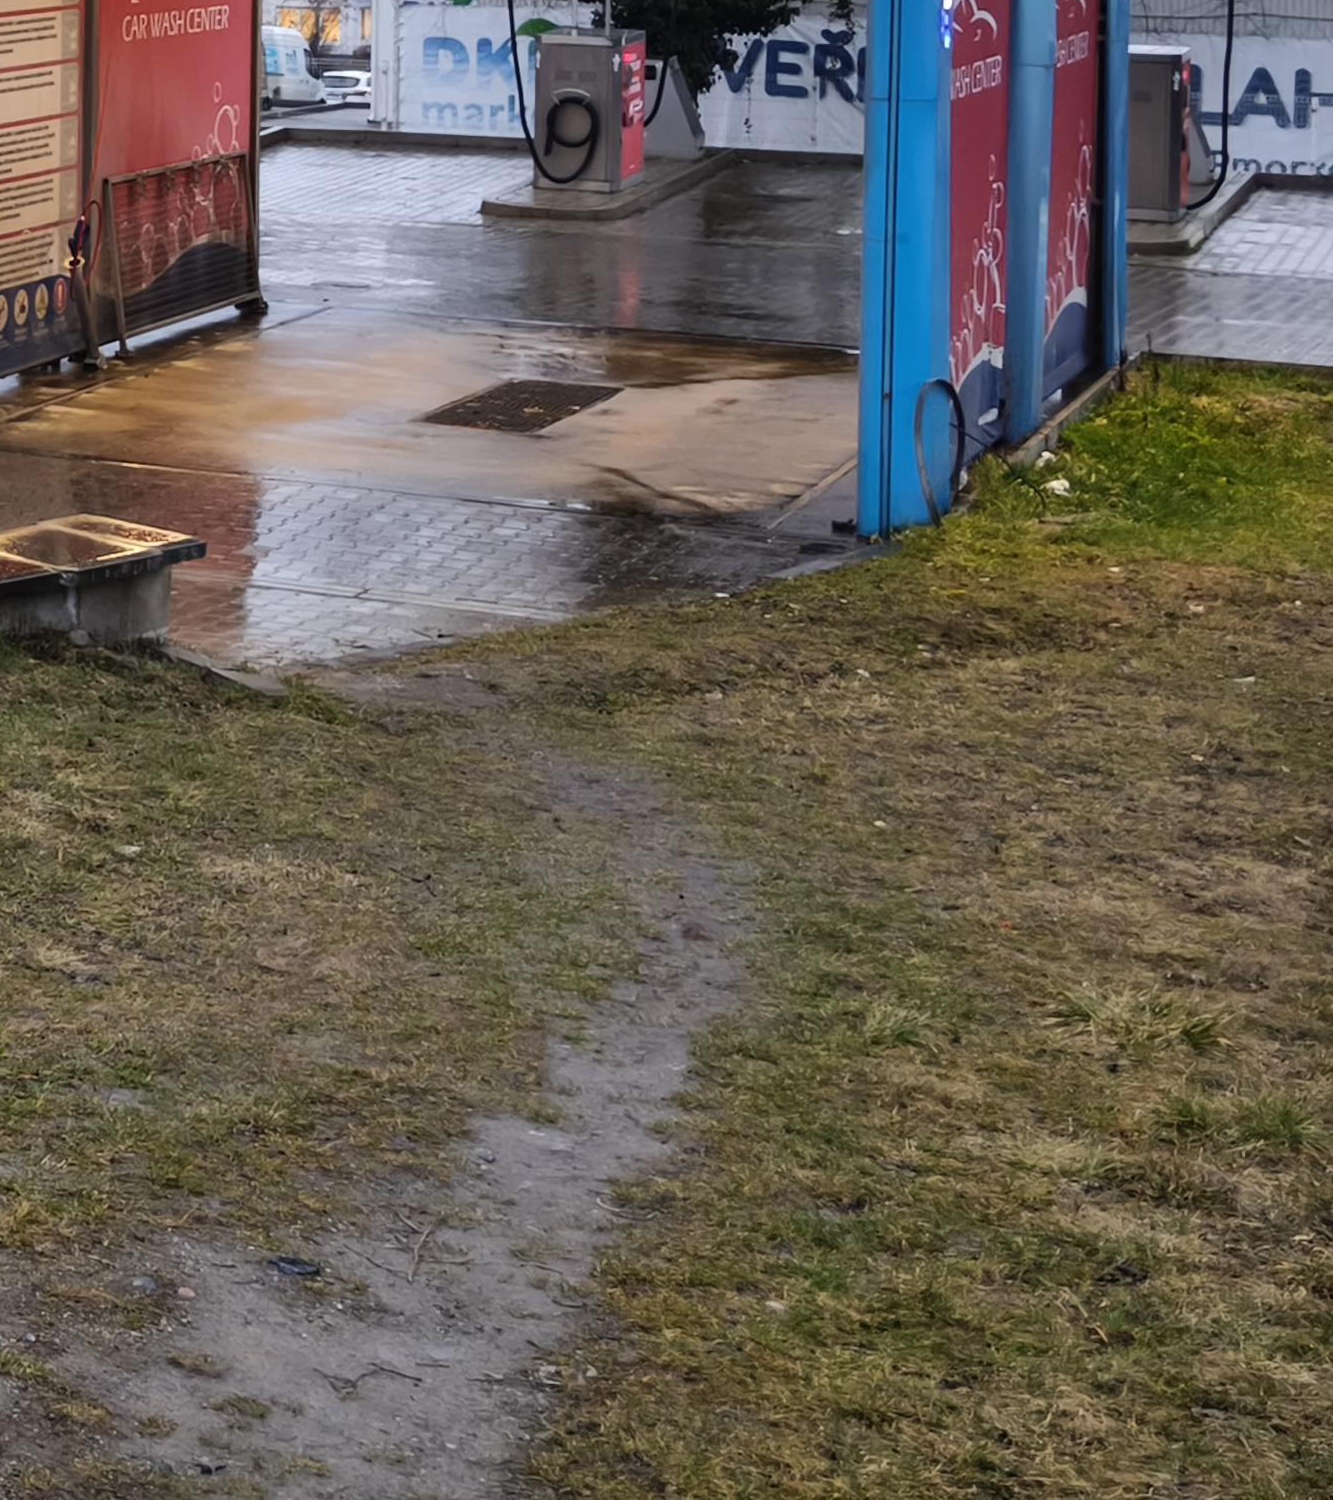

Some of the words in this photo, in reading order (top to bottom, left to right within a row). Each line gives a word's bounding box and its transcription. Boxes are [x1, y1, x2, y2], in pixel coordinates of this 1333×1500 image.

[122, 14, 148, 42] CAR
[149, 10, 185, 38] WASH
[186, 4, 229, 33] CENTER
[422, 36, 537, 88] DK
[721, 28, 867, 103] VEŘ
